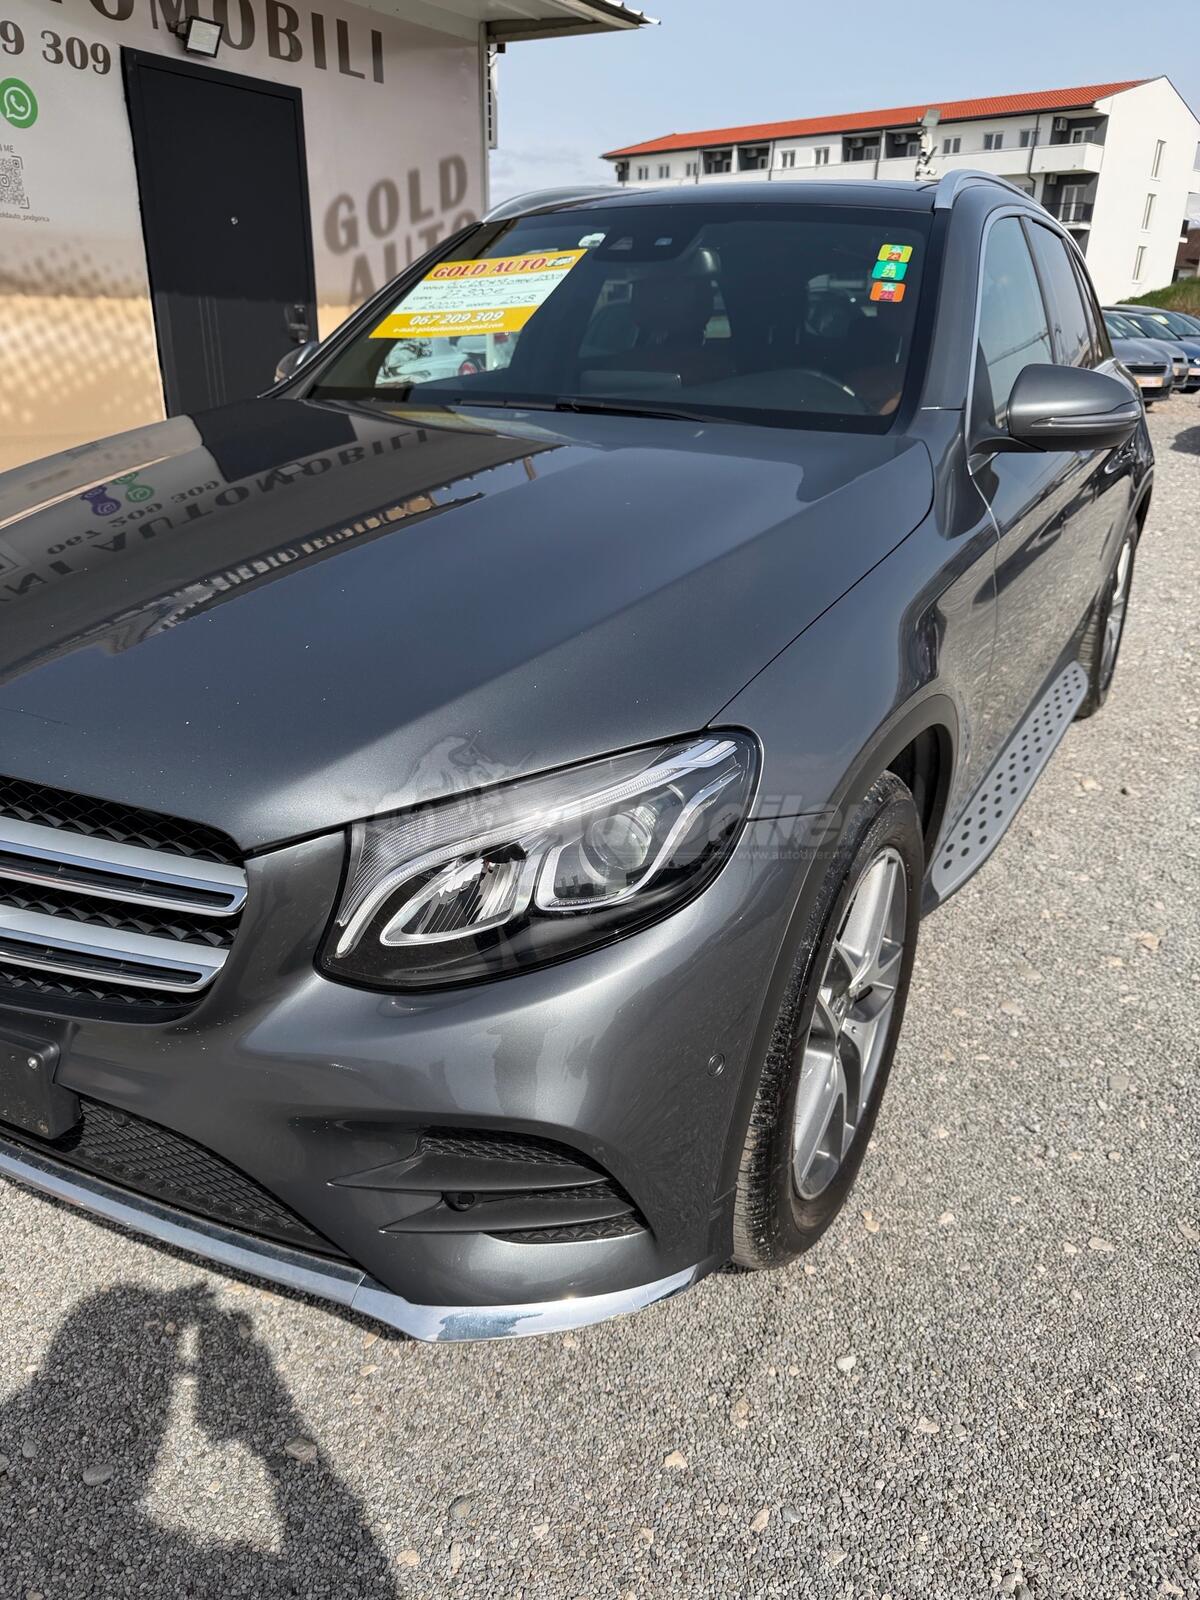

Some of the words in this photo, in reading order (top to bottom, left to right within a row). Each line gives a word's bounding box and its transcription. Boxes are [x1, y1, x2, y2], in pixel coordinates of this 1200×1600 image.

[40, 30, 111, 75] 309
[52, 0, 384, 84] OBILI
[324, 154, 468, 256] GOLD
[433, 263, 488, 279] GOLD
[494, 257, 547, 274] AUTO
[409, 314, 440, 326] 067
[440, 312, 472, 324] 209
[471, 310, 505, 323] 309
